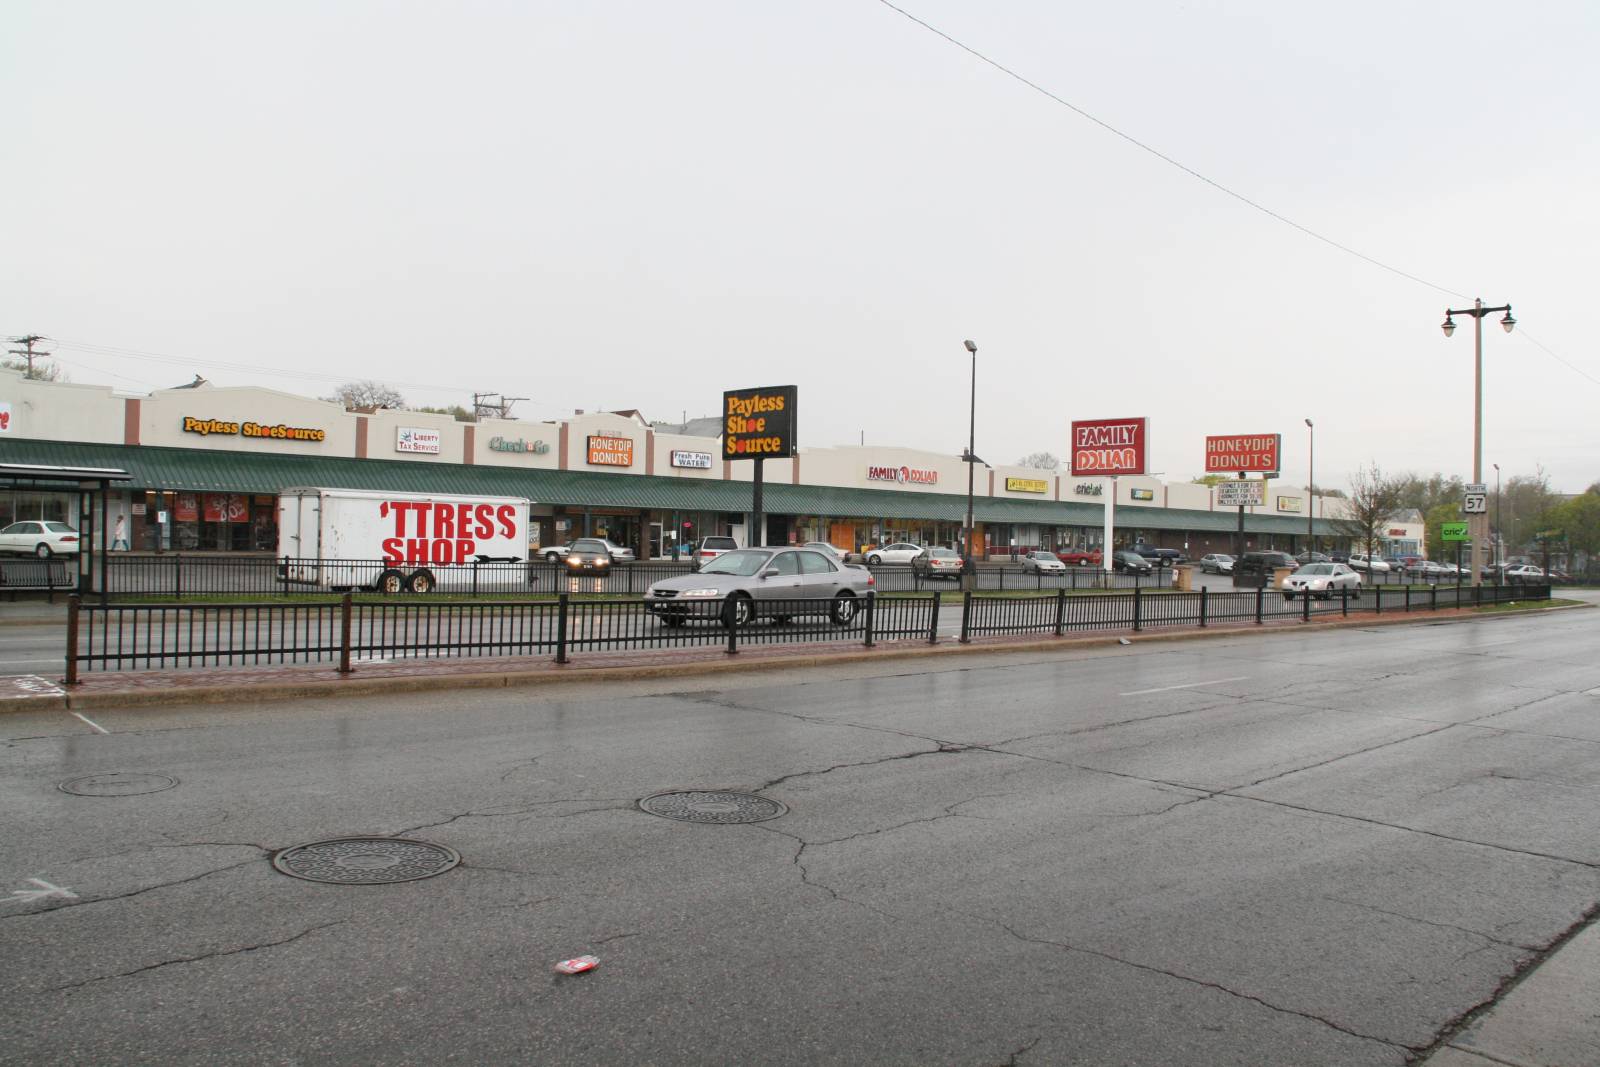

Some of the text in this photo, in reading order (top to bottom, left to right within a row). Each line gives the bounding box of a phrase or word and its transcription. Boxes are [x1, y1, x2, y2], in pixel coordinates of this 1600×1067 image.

[728, 394, 785, 417] Payless
[184, 417, 325, 441] Payless ShoeSource
[728, 416, 766, 434] Shoe
[1077, 425, 1138, 447] FAMILY
[590, 438, 632, 452] HONEYDIP
[727, 436, 781, 454] Source
[1208, 438, 1274, 453] HONEYDIP
[592, 452, 629, 465] DONUTS
[674, 452, 692, 460] Fresh
[679, 459, 706, 467] WATER
[1077, 448, 1136, 470] DOLLAR
[1210, 454, 1272, 468] DONUTS
[869, 466, 938, 483] FAMILY DOLLAR
[1468, 498, 1483, 509] 57
[382, 538, 476, 567] SHOP
